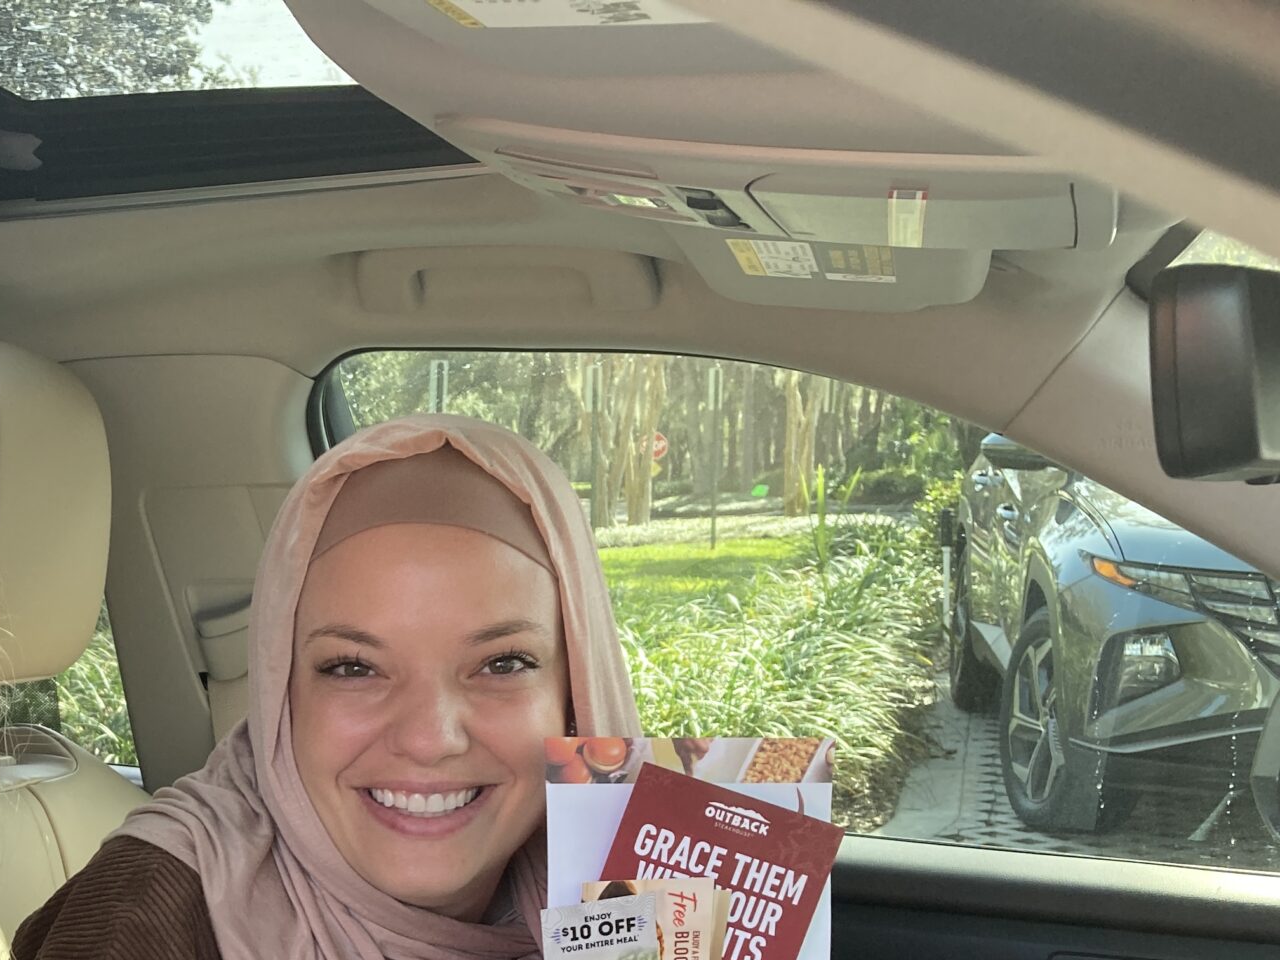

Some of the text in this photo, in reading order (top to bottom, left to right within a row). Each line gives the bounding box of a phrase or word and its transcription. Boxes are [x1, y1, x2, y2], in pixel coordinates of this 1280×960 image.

[704, 806, 770, 836] OUTBACK
[634, 823, 808, 906] GRACE THEM
[584, 911, 612, 923] ENJOY
[667, 891, 697, 928] Free
[716, 885, 783, 936] OUR
[562, 916, 637, 942] $10 OFF
[691, 930, 700, 949] ENJOY
[560, 943, 583, 953] YOUR
[585, 938, 614, 950] ENTIRE
